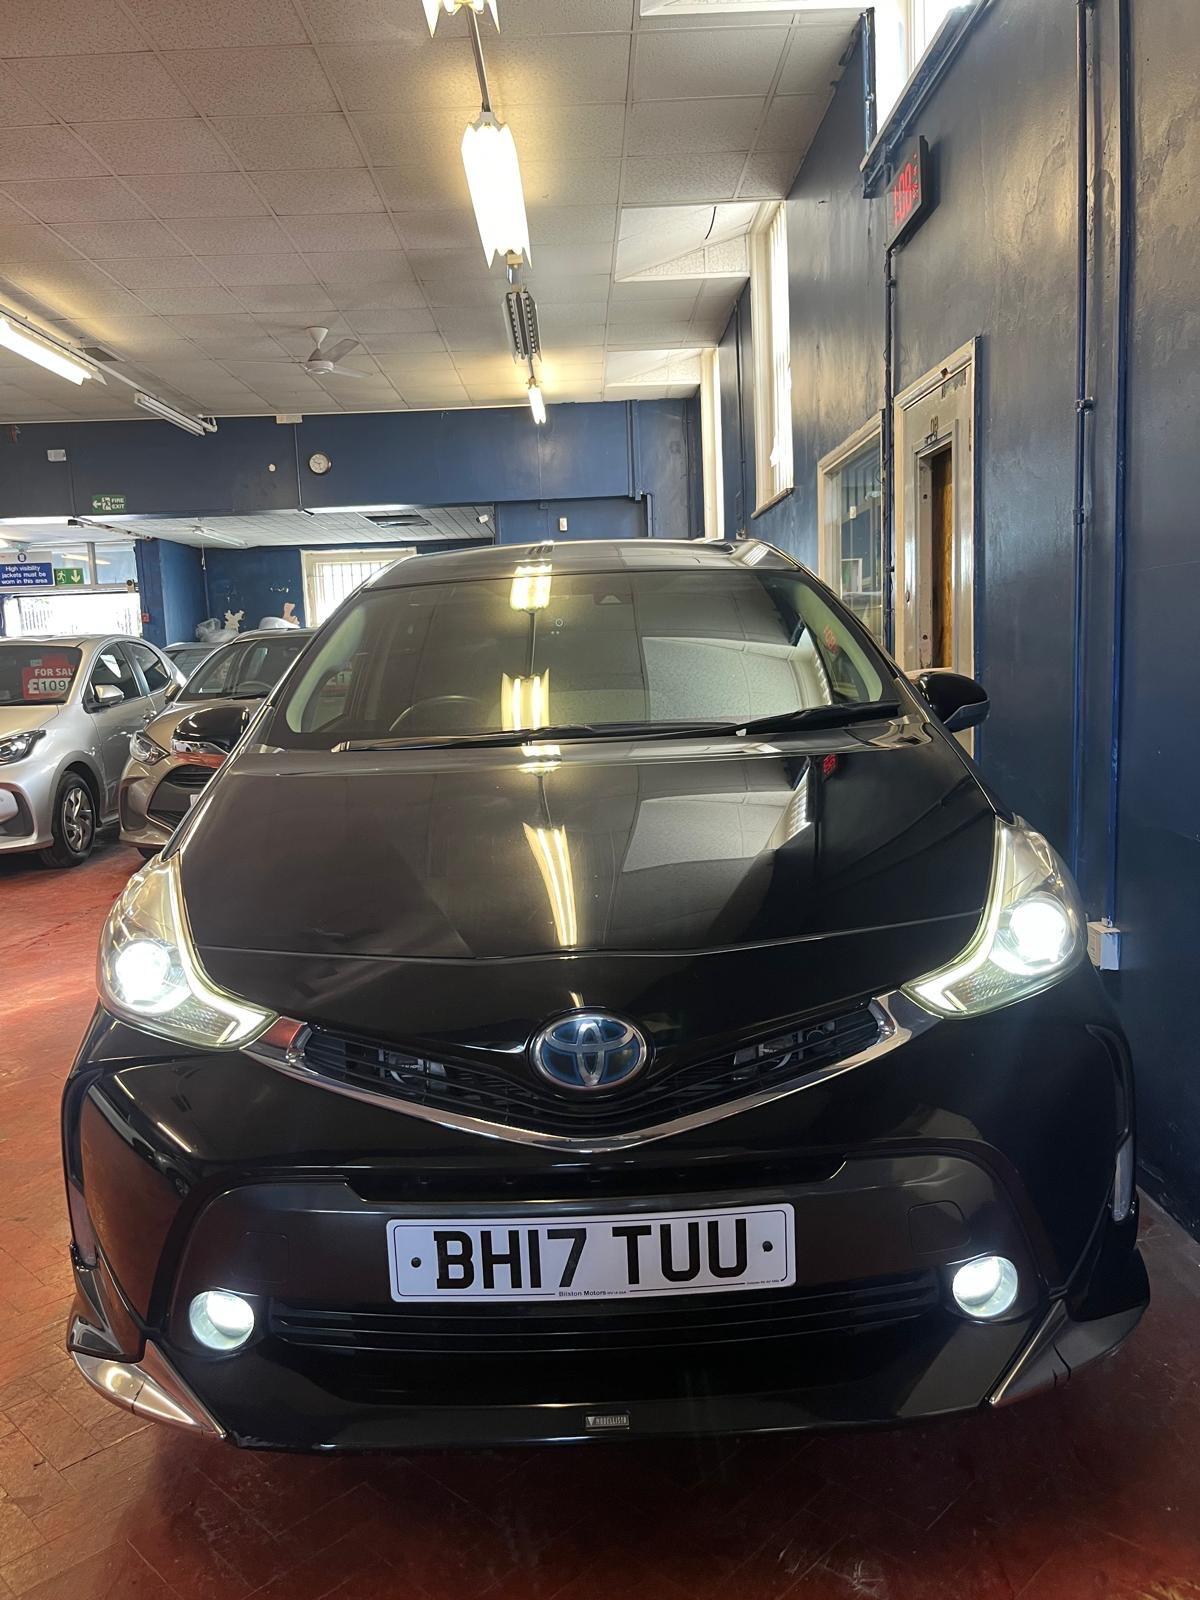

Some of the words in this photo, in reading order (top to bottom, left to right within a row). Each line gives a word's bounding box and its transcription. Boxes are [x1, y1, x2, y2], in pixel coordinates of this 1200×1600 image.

[34, 668, 54, 676] FOR
[55, 668, 75, 676] SAL
[28, 678, 68, 694] £109
[433, 1228, 587, 1290] BH17
[612, 1218, 748, 1285] TUU
